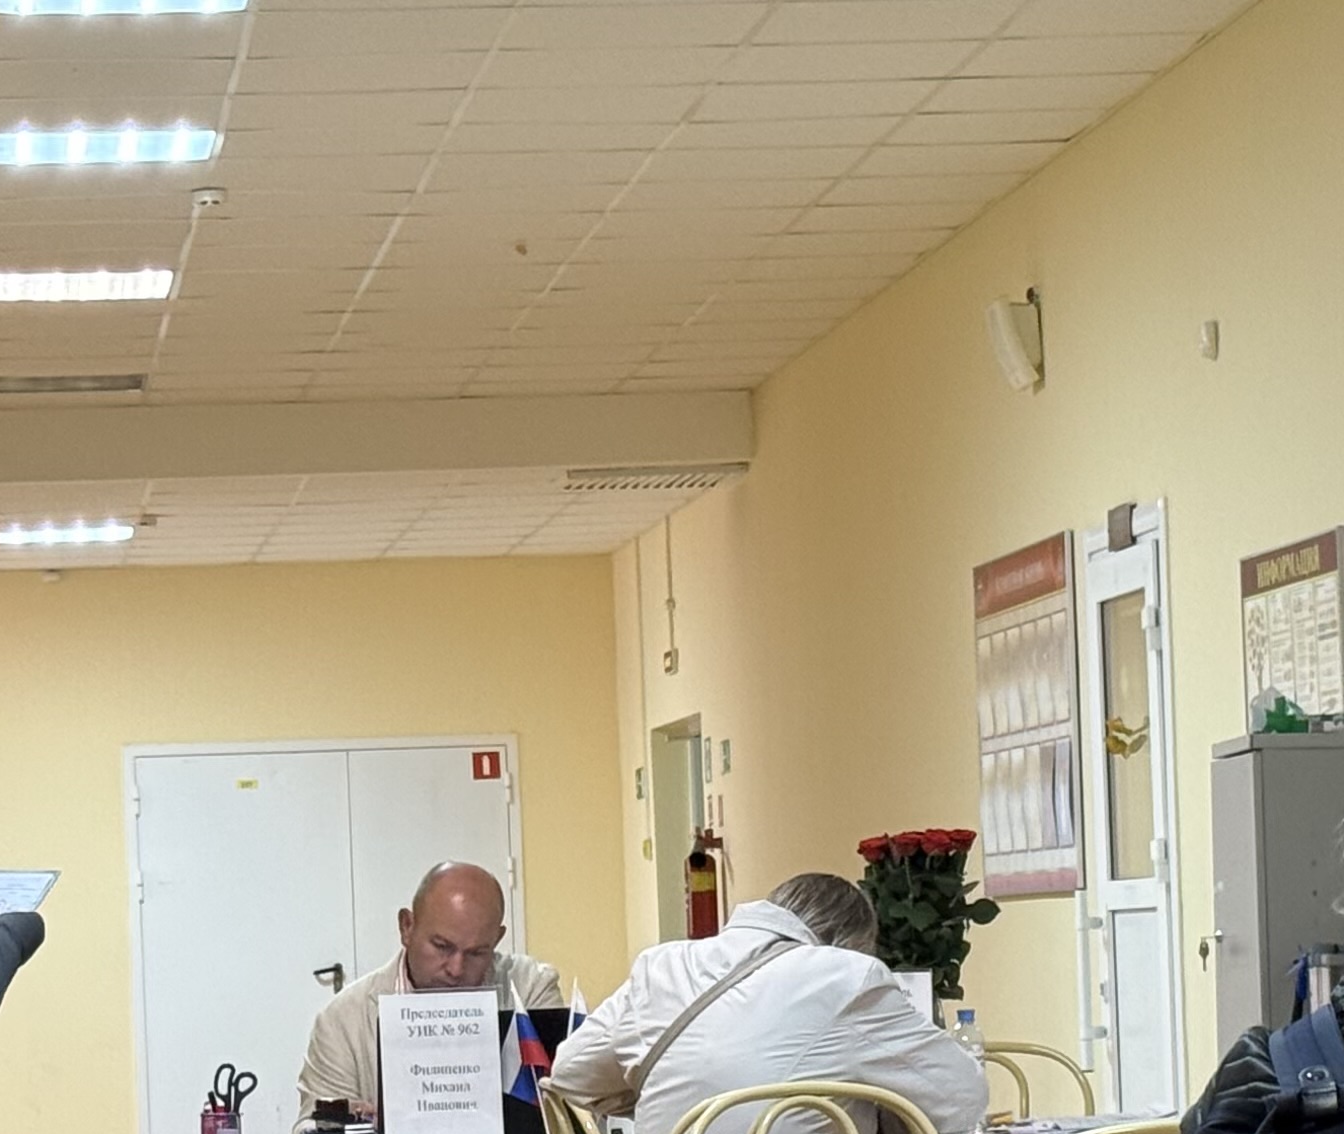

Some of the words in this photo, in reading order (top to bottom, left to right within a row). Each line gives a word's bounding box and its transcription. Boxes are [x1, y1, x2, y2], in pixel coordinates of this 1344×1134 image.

[1256, 544, 1320, 589] ИНФОРМАЦИЯ
[400, 1007, 484, 1022] Председатель
[407, 1025, 438, 1038] УИК
[441, 1024, 455, 1036] №
[457, 1023, 481, 1036] 962
[421, 1081, 471, 1094] Михаил
[417, 1099, 479, 1112] Иванович
